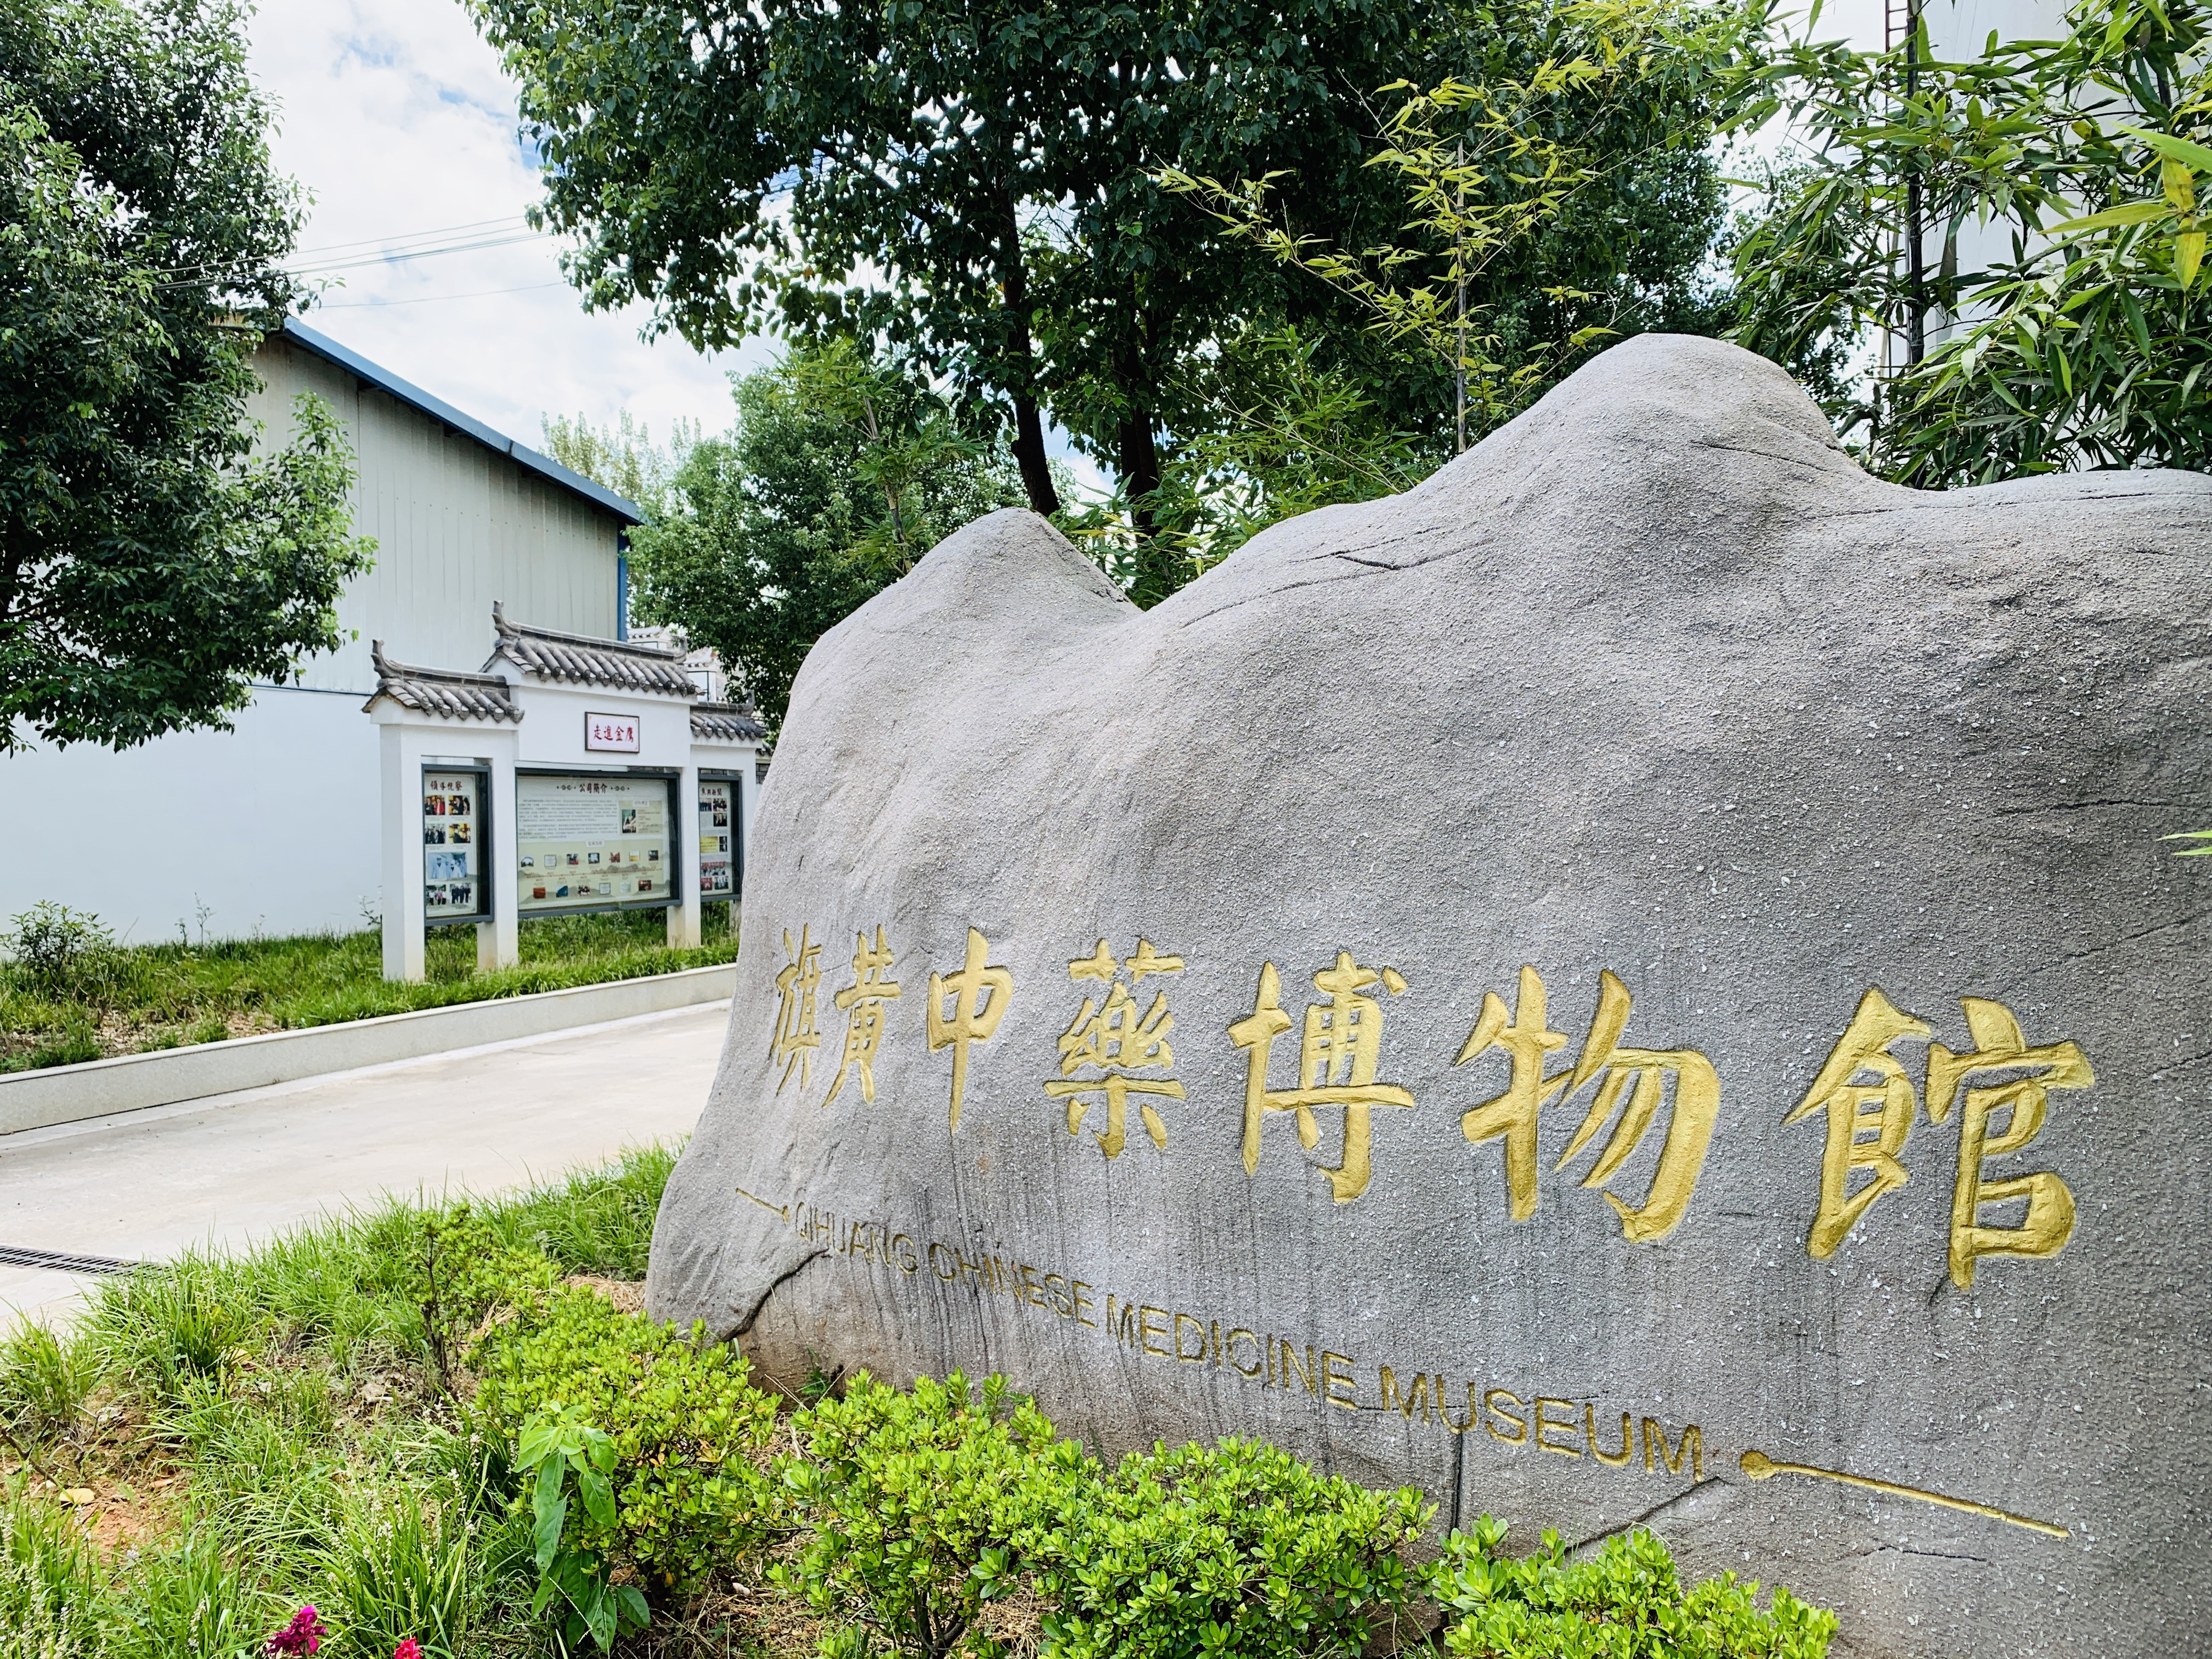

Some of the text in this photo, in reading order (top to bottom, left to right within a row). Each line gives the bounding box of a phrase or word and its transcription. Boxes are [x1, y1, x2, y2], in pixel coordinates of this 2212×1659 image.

[795, 1201, 1703, 1482] QIHUANG CHINESE MEDICINE MUSEUM
